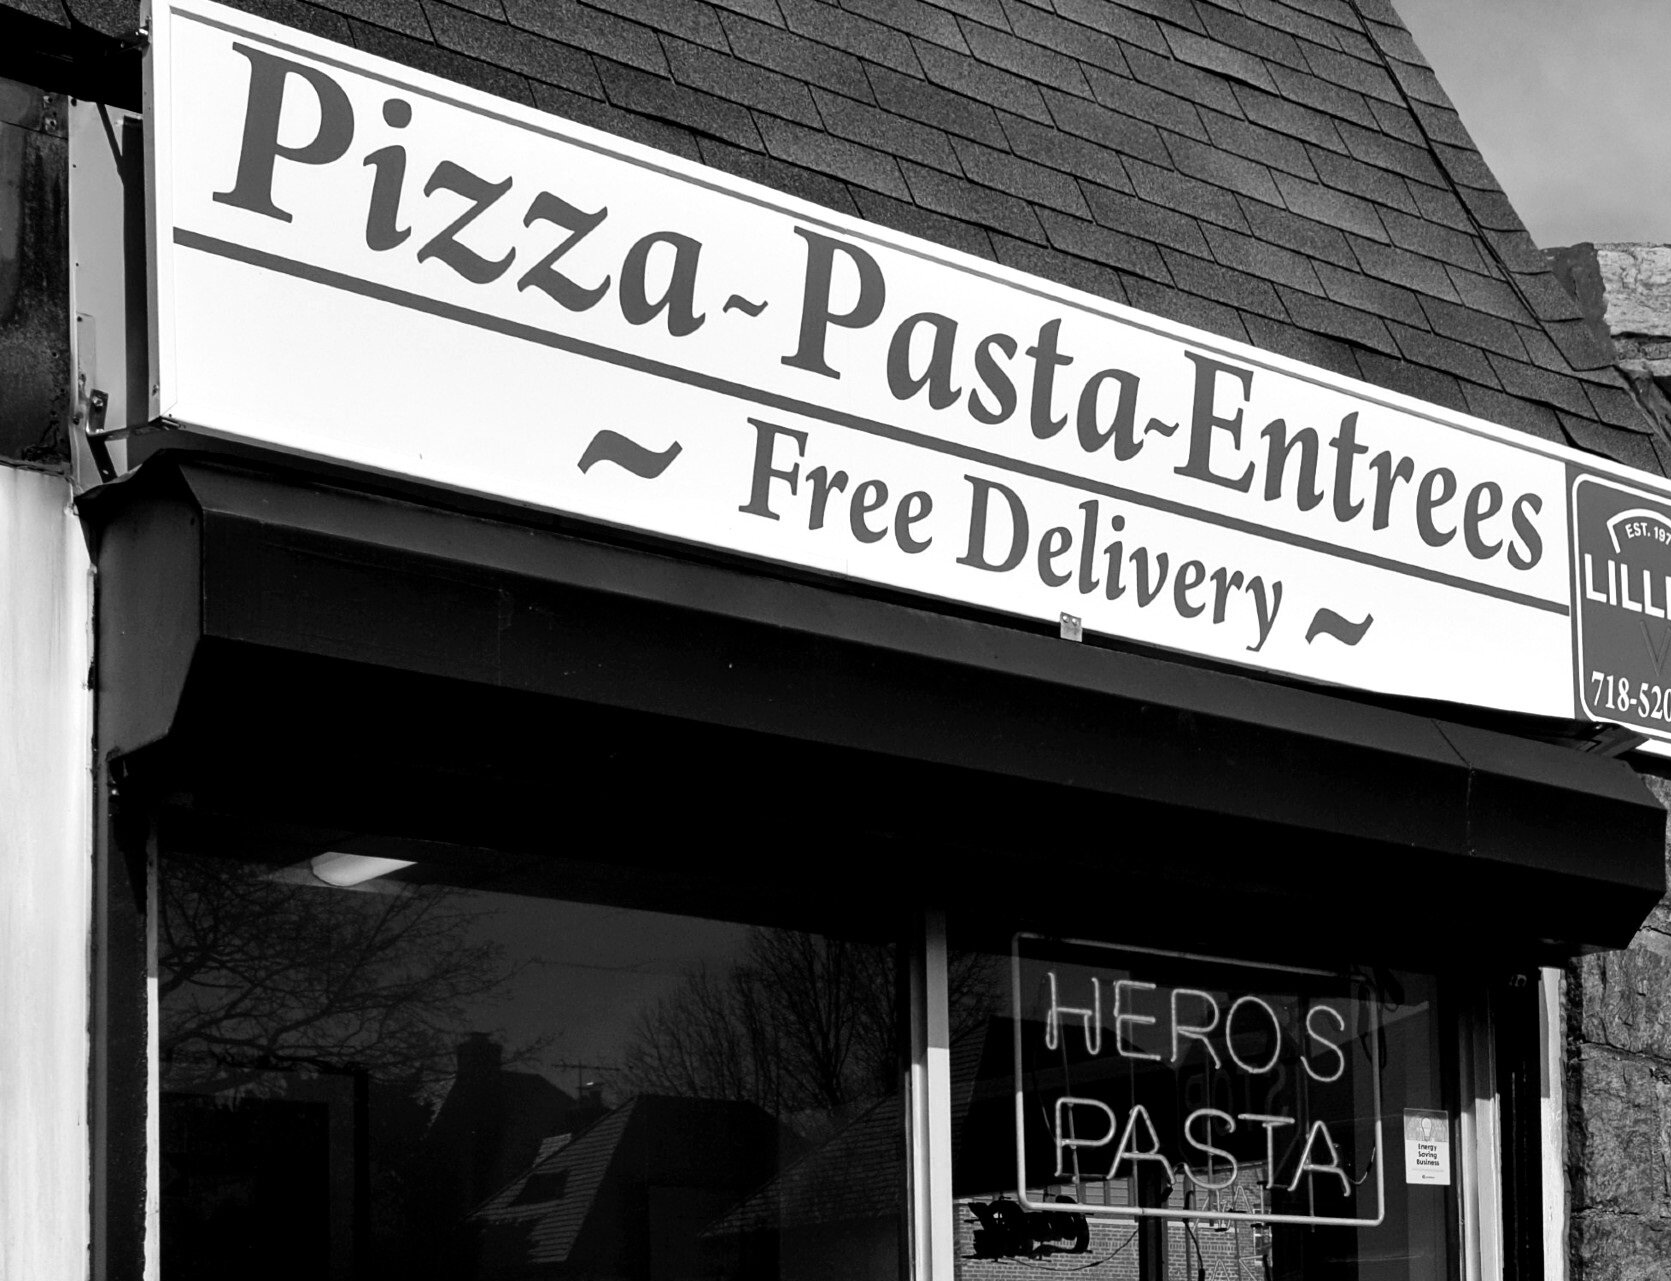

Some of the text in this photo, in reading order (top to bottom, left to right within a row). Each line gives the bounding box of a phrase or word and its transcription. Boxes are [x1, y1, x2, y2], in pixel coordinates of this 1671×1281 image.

[738, 417, 1283, 652] Free Delivery
[1625, 522, 1650, 539] EST.
[1054, 1097, 1351, 1196] PASTA
[1418, 1143, 1437, 1151] Energy
[1418, 1151, 1437, 1159] Saving
